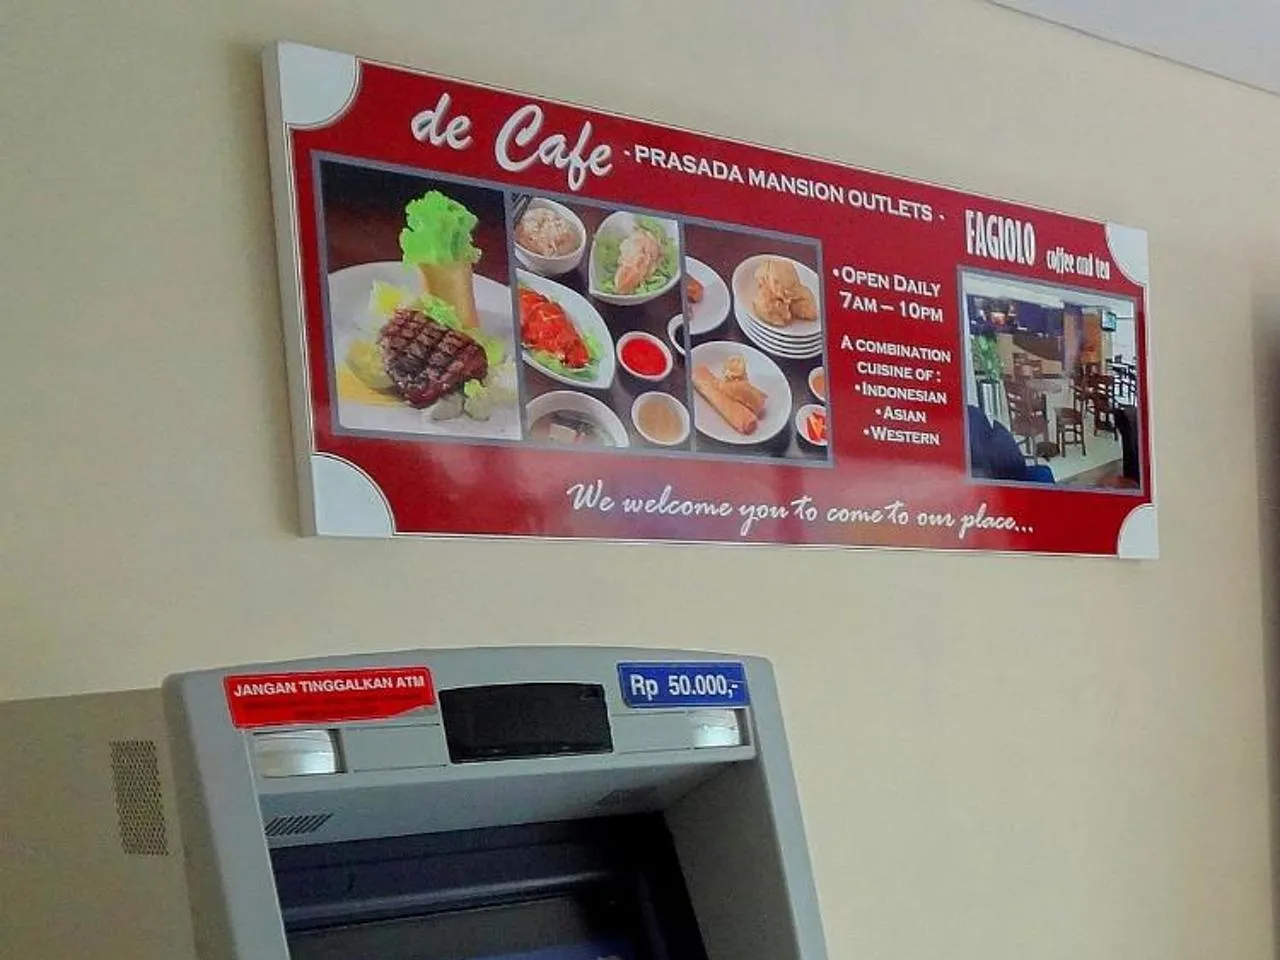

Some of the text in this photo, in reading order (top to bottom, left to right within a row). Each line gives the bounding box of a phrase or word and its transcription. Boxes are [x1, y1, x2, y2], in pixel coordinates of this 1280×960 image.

[410, 92, 615, 192] de Cafe
[634, 144, 744, 184] PRASADA
[748, 168, 844, 204] MANSION
[848, 188, 933, 222] OUTLETS
[964, 209, 1036, 266] FAGIOLO
[1046, 246, 1075, 275] coffee
[840, 334, 952, 363] A COMBINATION
[856, 361, 913, 380] CUISINE
[861, 382, 948, 405] INDONESIAN
[883, 405, 927, 423] ASIAN
[870, 426, 940, 446] WESTERN
[566, 480, 615, 512] We
[621, 484, 733, 518] welcome
[738, 502, 789, 537] you
[788, 494, 819, 522] to
[825, 506, 884, 525] come
[883, 499, 910, 526] to
[916, 512, 955, 528] our
[233, 675, 425, 698] JANGAN TINGGALKAN ATM
[628, 672, 740, 701] Rp 50.000,-
